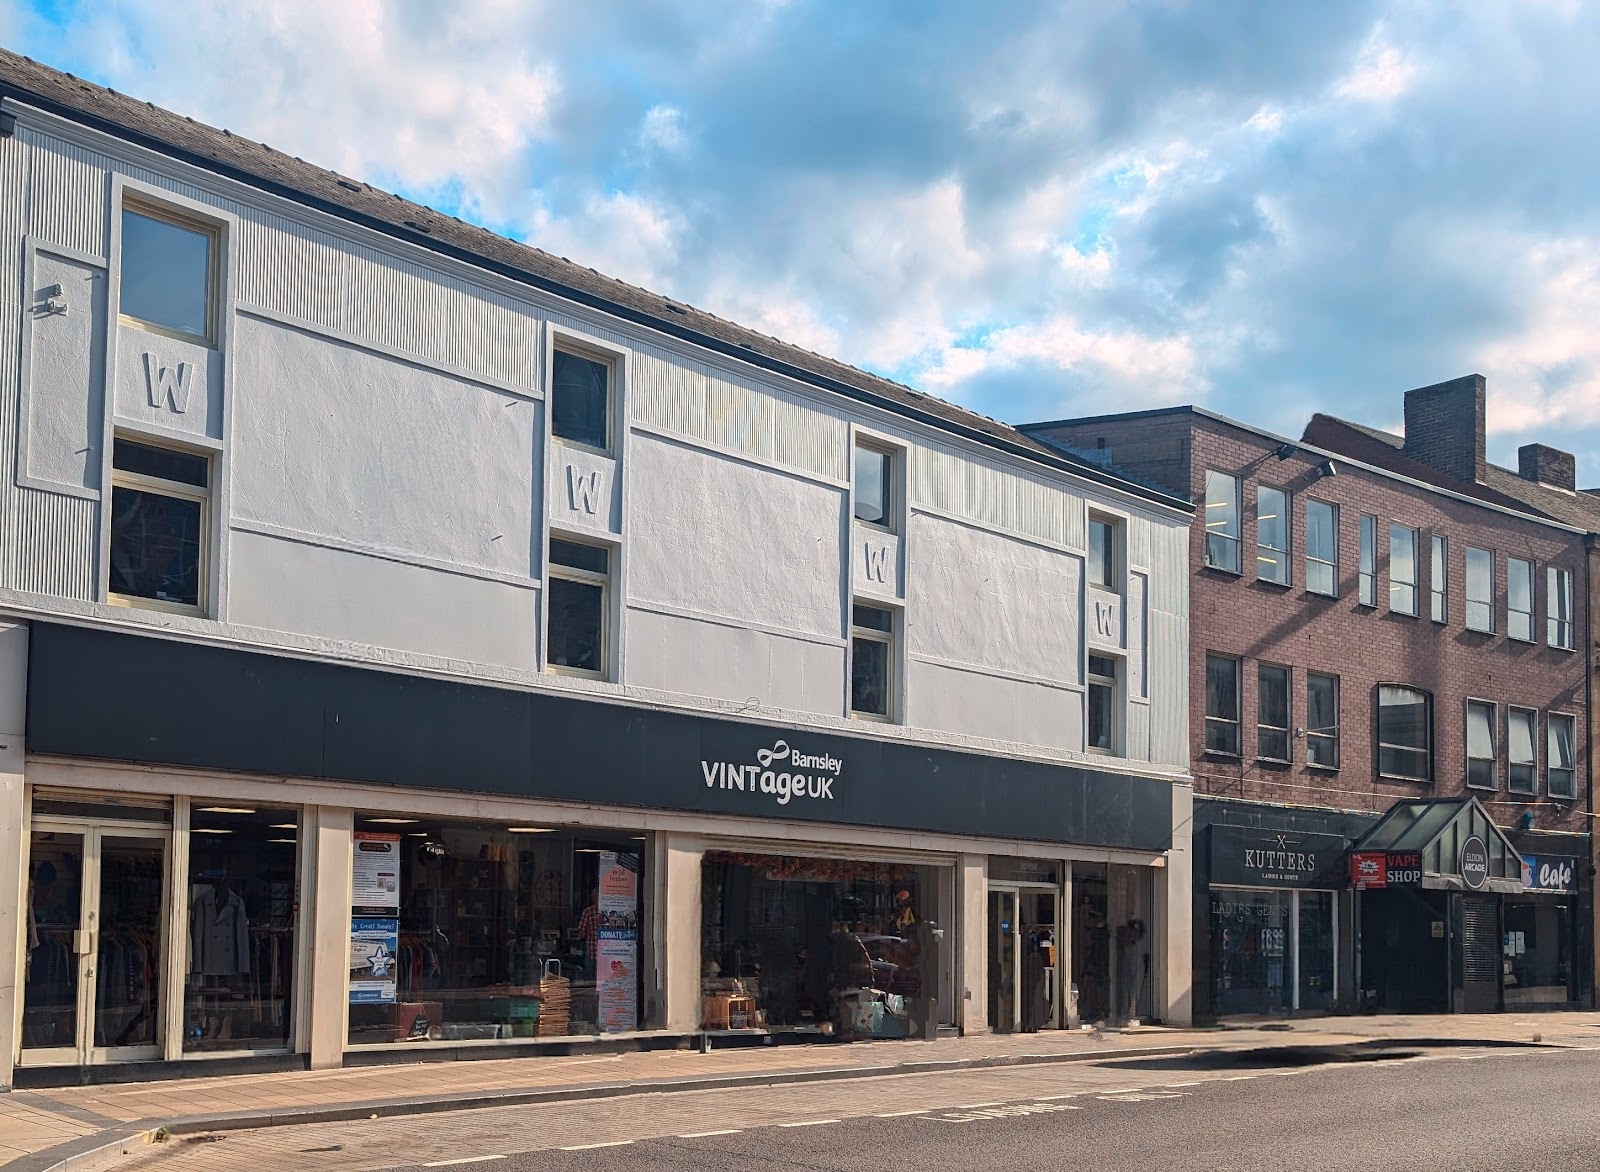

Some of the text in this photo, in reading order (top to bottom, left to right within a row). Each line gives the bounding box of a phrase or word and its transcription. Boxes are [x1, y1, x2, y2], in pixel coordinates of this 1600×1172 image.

[142, 352, 194, 414] W
[566, 465, 602, 514] W
[865, 541, 890, 583] W
[1095, 601, 1116, 637] W
[791, 749, 843, 776] Barnsley
[1244, 849, 1315, 872] KUTTERS
[1386, 855, 1419, 867] VAPE
[1464, 863, 1486, 872] ARCADE
[1466, 853, 1484, 862] ELDON
[1386, 870, 1421, 883] SHOP
[600, 930, 623, 939] DONATE
